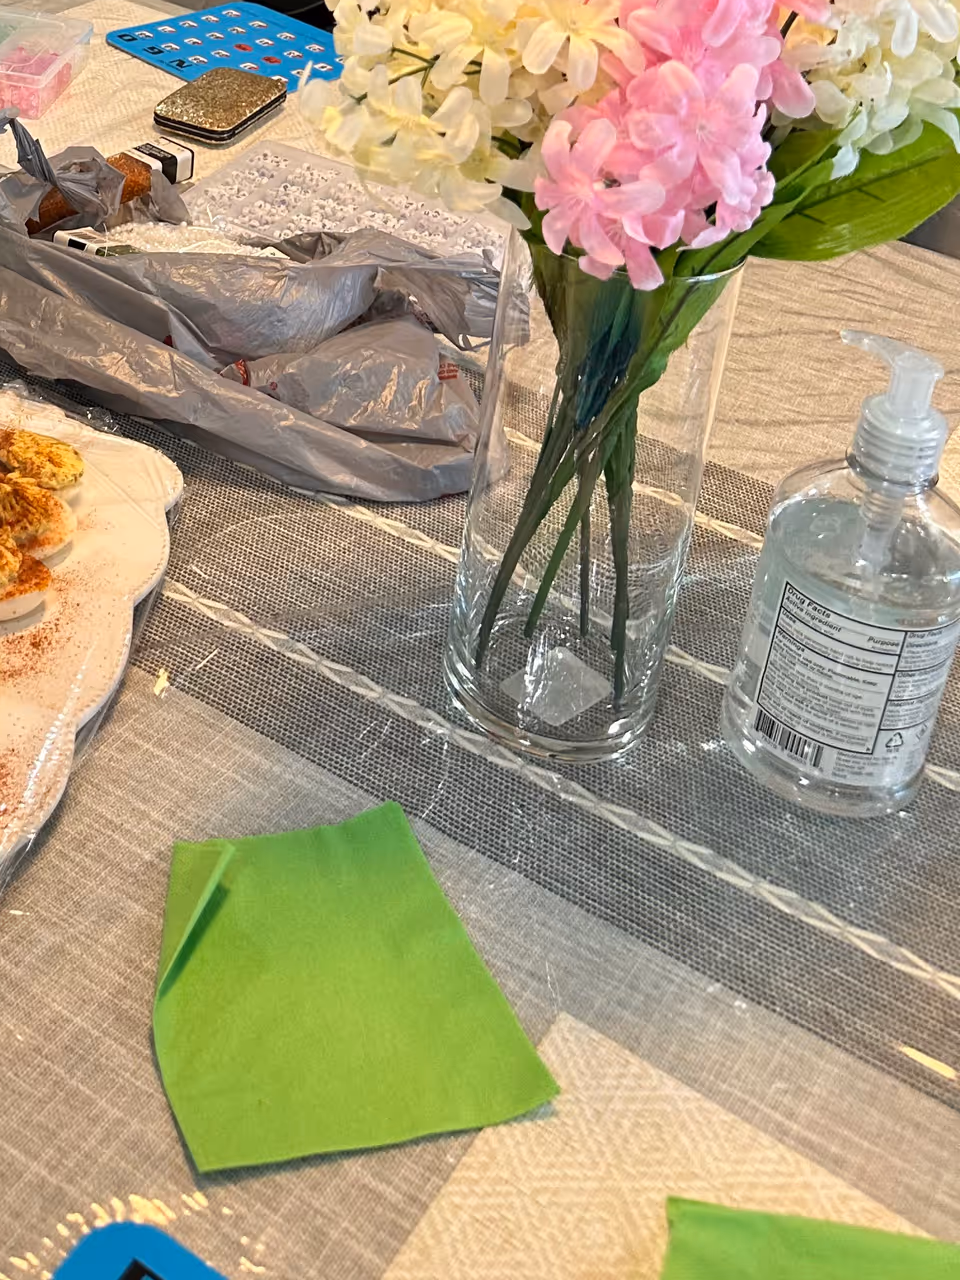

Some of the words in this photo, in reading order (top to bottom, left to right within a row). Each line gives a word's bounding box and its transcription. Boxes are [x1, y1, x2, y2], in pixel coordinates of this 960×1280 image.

[784, 596, 805, 612] Active
[787, 586, 806, 604] Drug
[806, 601, 832, 619] Facts
[777, 629, 806, 653] Warnings
[867, 636, 900, 647] Purpose
